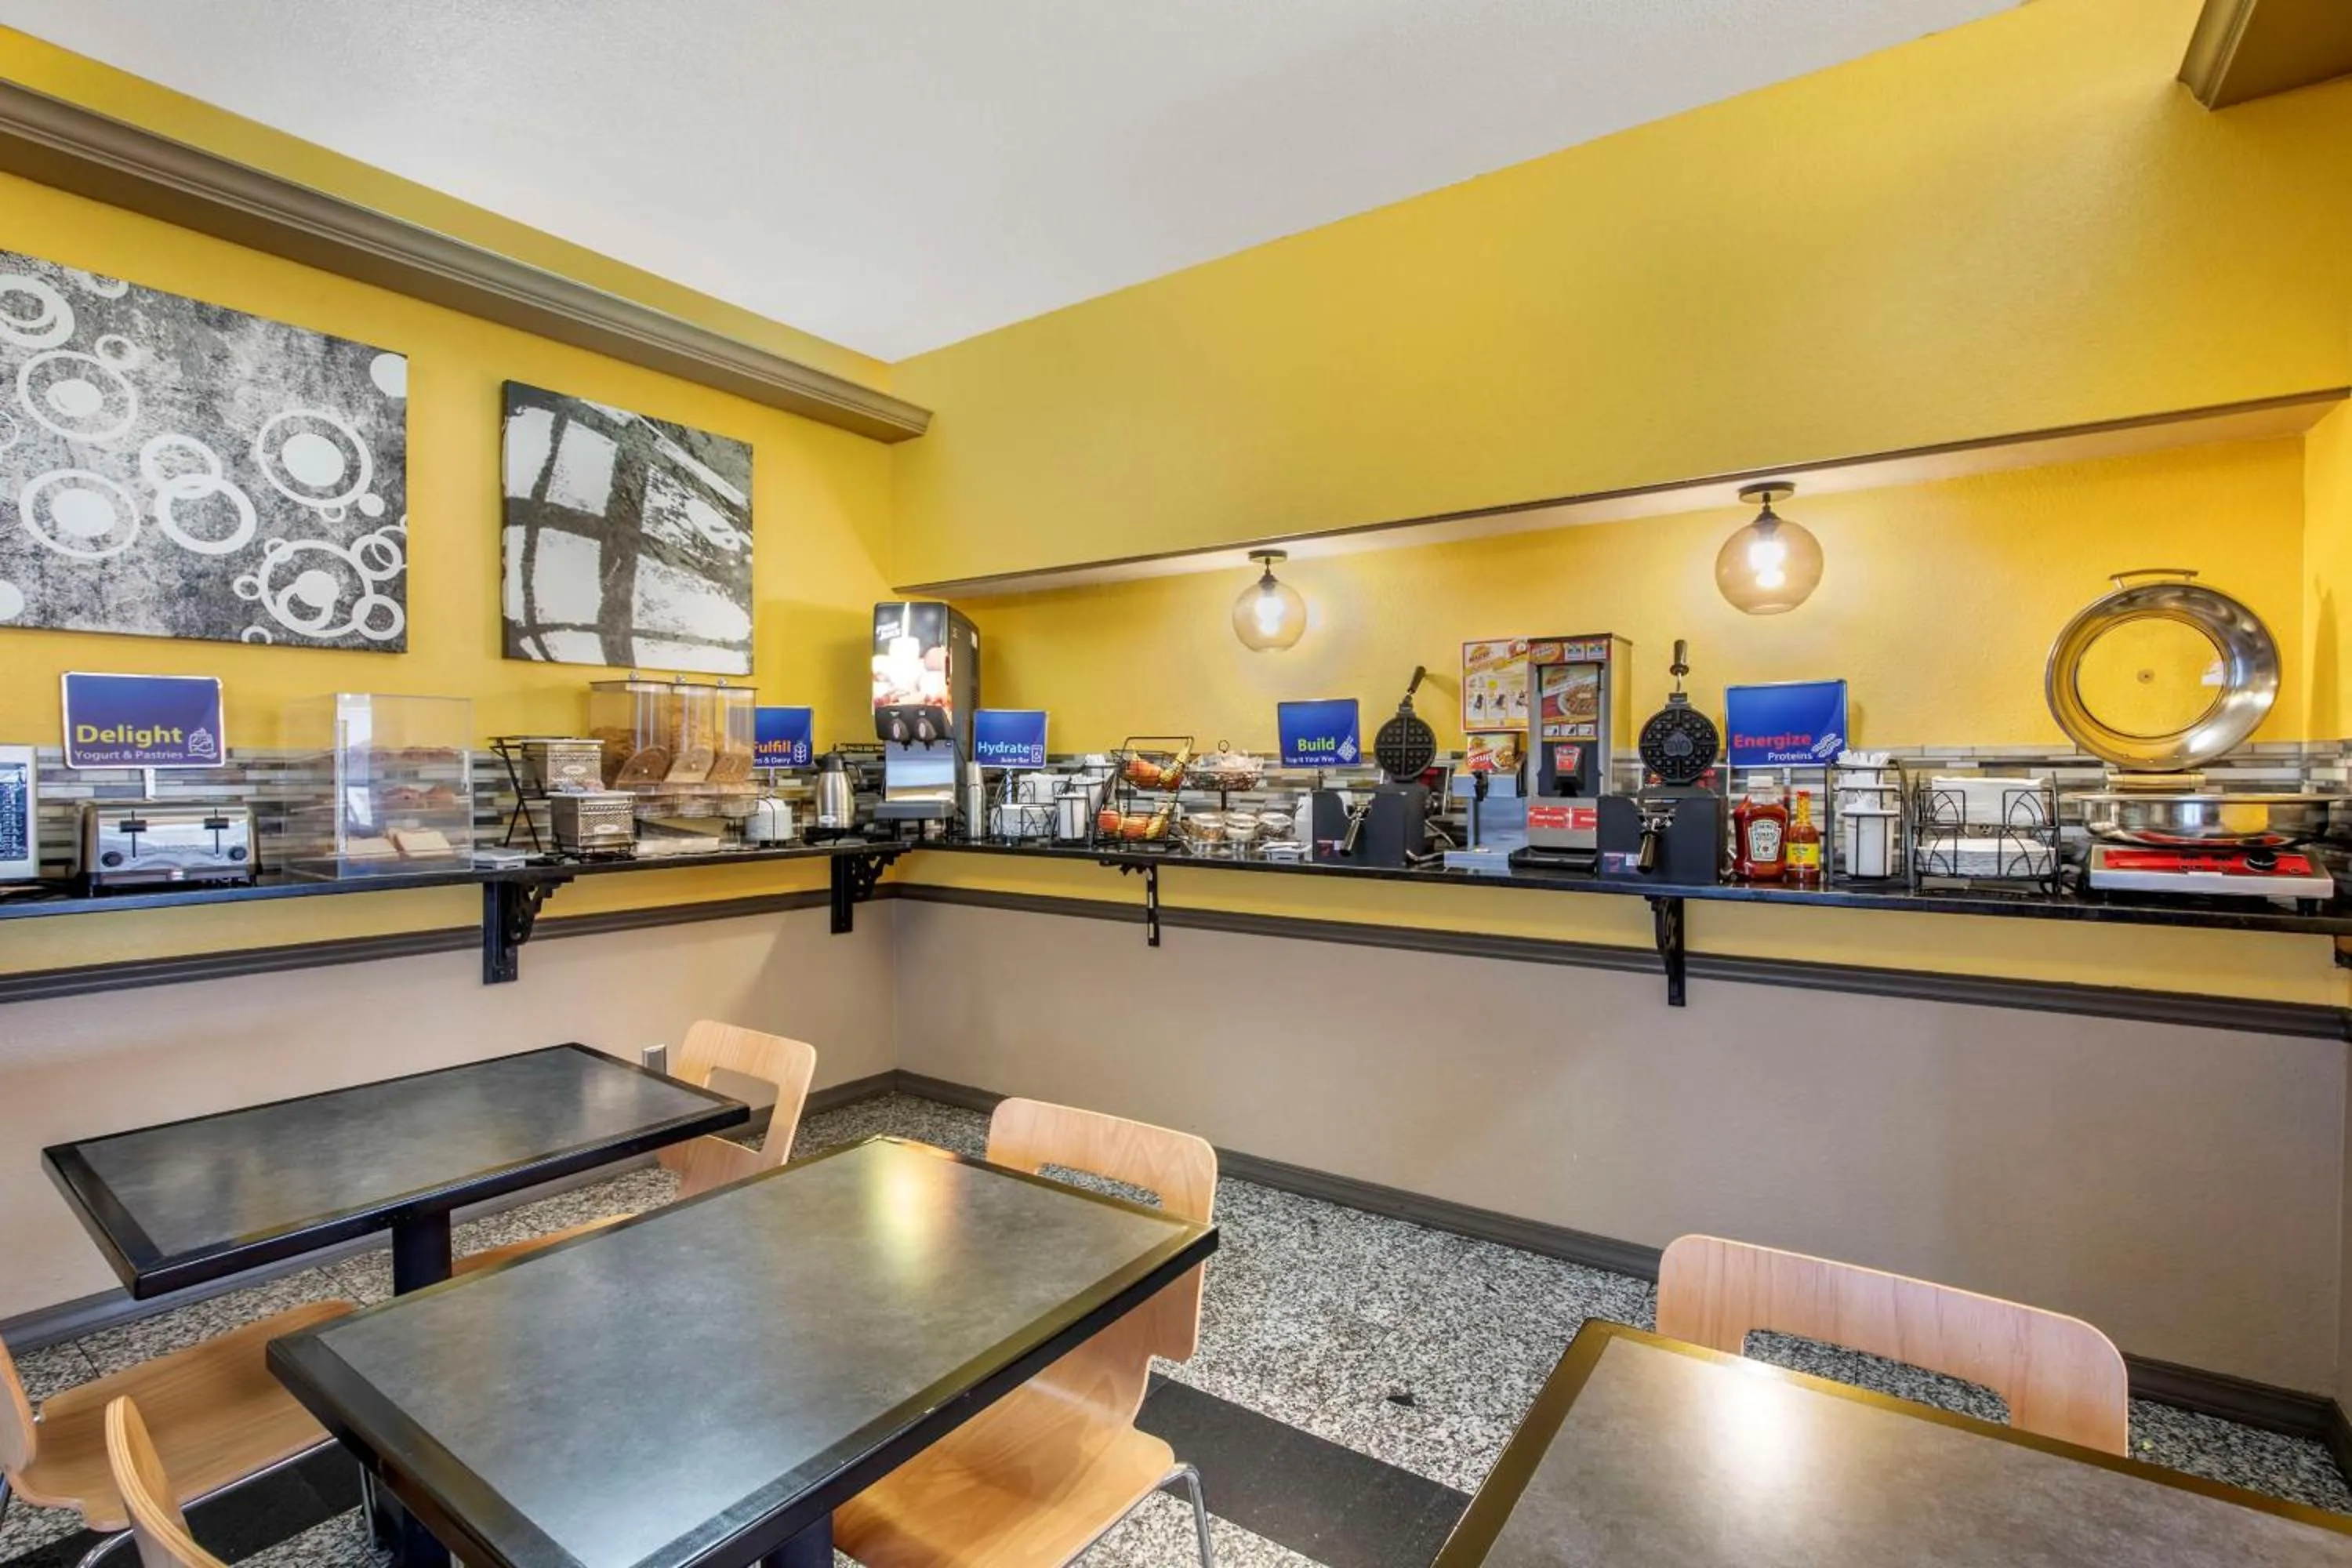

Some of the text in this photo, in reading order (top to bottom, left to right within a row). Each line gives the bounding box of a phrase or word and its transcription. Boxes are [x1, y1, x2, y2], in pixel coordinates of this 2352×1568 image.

[76, 724, 182, 748] Delight
[1733, 732, 1811, 750] Energize
[978, 741, 1030, 756] Hydrate
[1298, 738, 1335, 752] Build
[74, 750, 183, 761] Yogurt & Pastries
[1768, 751, 1813, 760] Proteins
